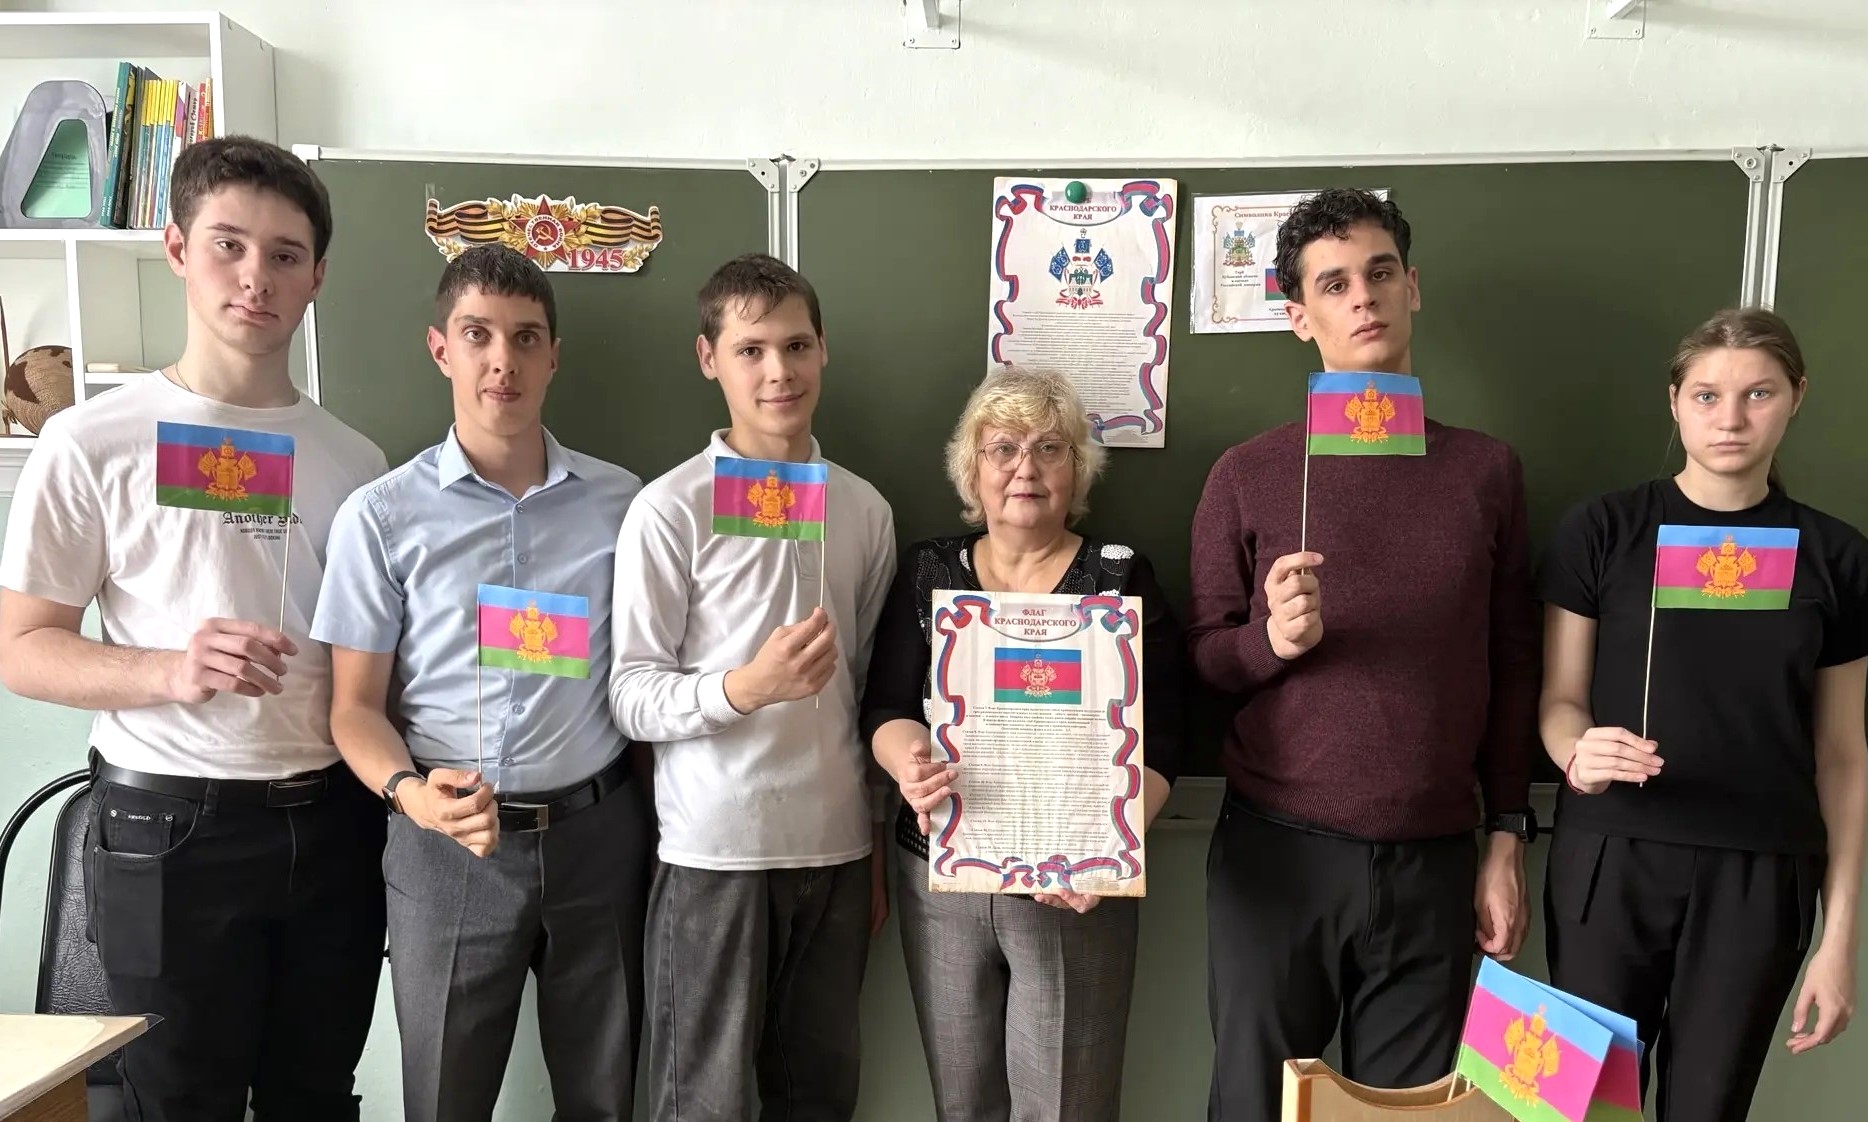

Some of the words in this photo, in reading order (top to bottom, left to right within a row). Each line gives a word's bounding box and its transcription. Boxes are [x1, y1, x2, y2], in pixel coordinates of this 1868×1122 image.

[1049, 204, 1117, 213] КРАСНОДАРСКОГО
[526, 215, 560, 248] ОТЕЧЕСТВЕННАЯ
[569, 248, 624, 270] 1945
[222, 511, 274, 526] Another
[1022, 608, 1047, 617] ФЛАГ
[994, 617, 1077, 627] КРАСНОДАРСКОГО
[1023, 628, 1048, 636] КРАЯ
